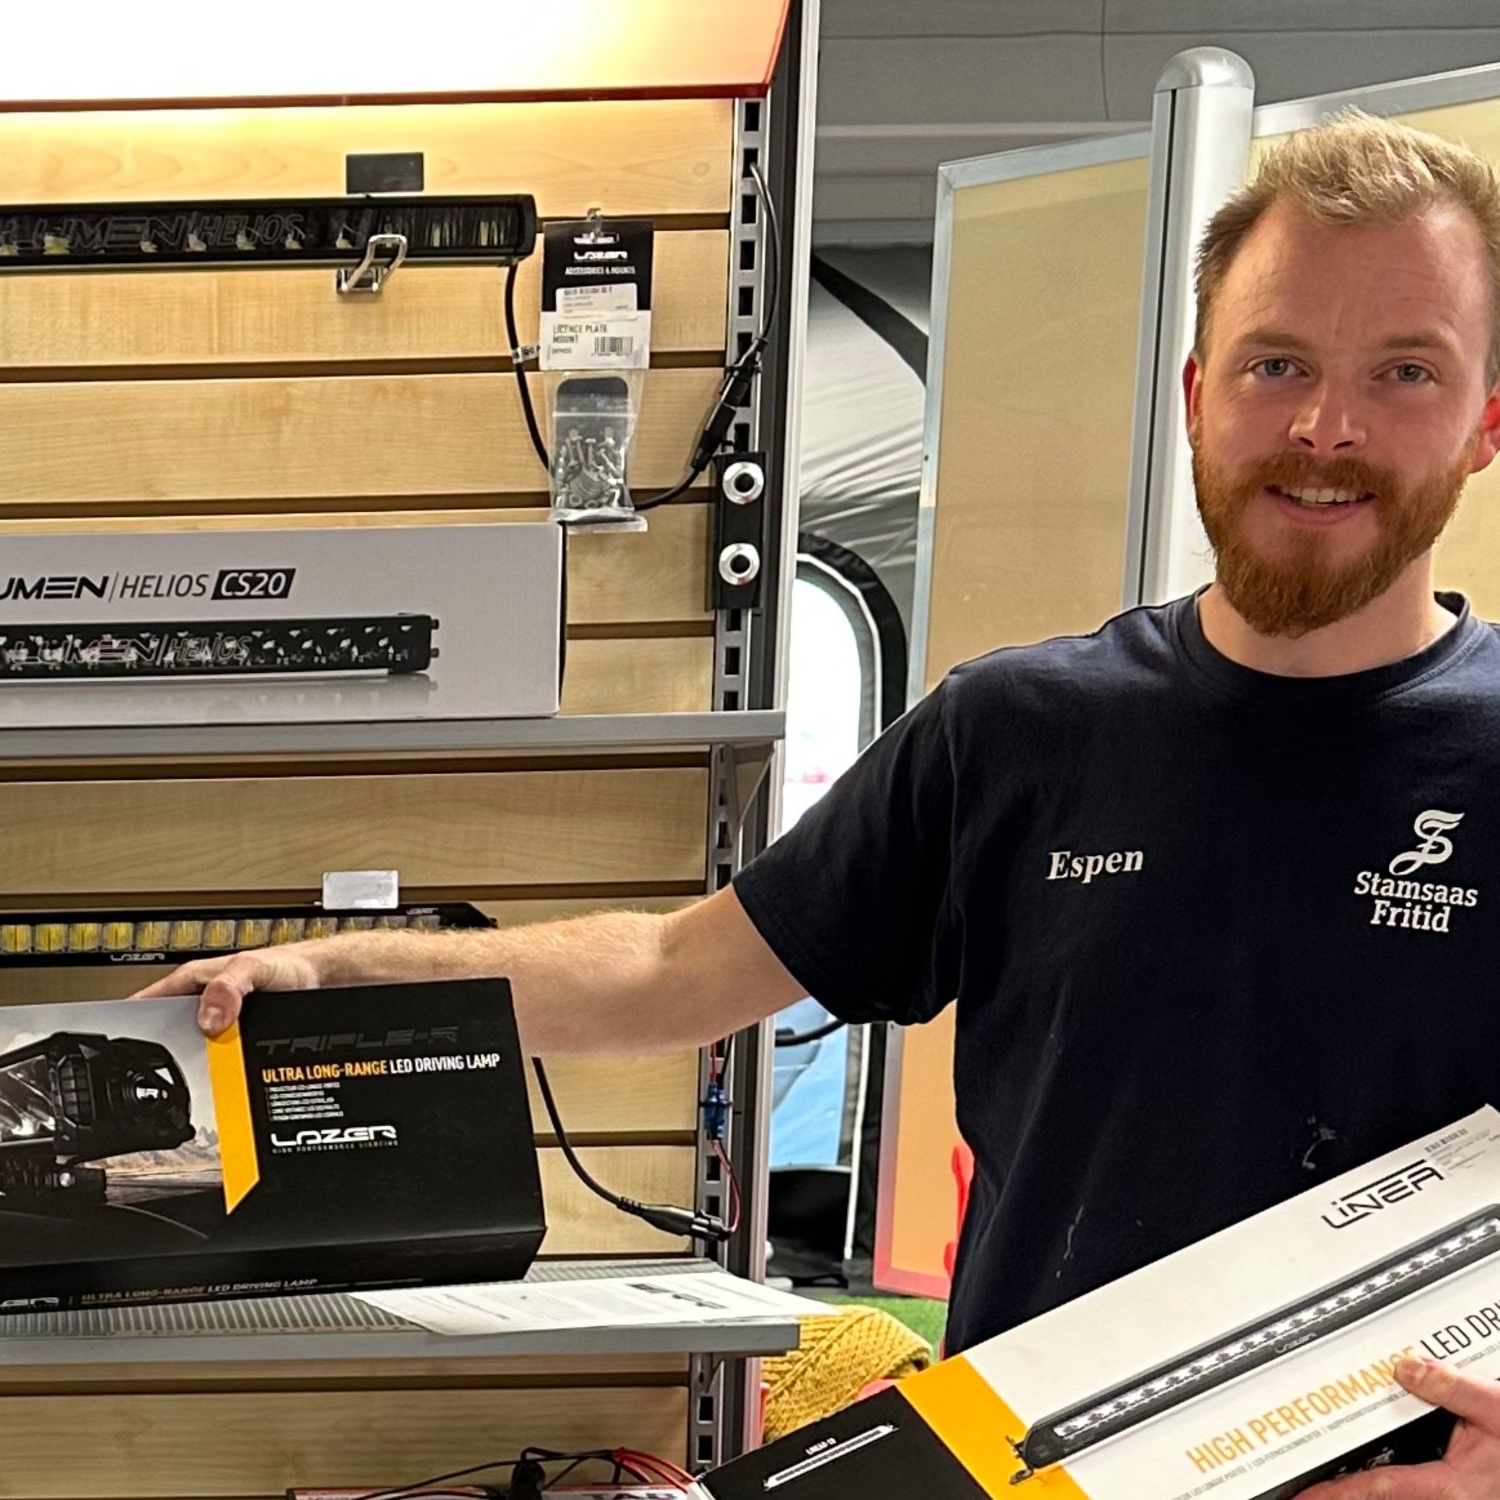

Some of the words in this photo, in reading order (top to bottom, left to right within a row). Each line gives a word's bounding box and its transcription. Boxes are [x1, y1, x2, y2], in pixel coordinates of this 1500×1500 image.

[119, 574, 208, 598] HELIOS
[219, 571, 286, 596] CS20
[13, 640, 158, 664] LUMEN
[168, 636, 253, 660] HELIOS
[1046, 849, 1144, 883] Espen
[1354, 871, 1479, 908] Stamsaas
[1370, 900, 1452, 933] Fritid
[255, 1026, 459, 1055] TRIPLE-R
[262, 1067, 305, 1084] ULTRA
[306, 1060, 387, 1080] LONG-RANGE
[390, 1058, 413, 1074] LED
[415, 1056, 465, 1073] DRIVING
[466, 1053, 501, 1069] LAMP
[271, 1125, 397, 1147] LAZER
[1420, 1325, 1471, 1360] LED
[1186, 1428, 1253, 1474] HIGH
[1247, 1346, 1413, 1446] PERFORMAN
